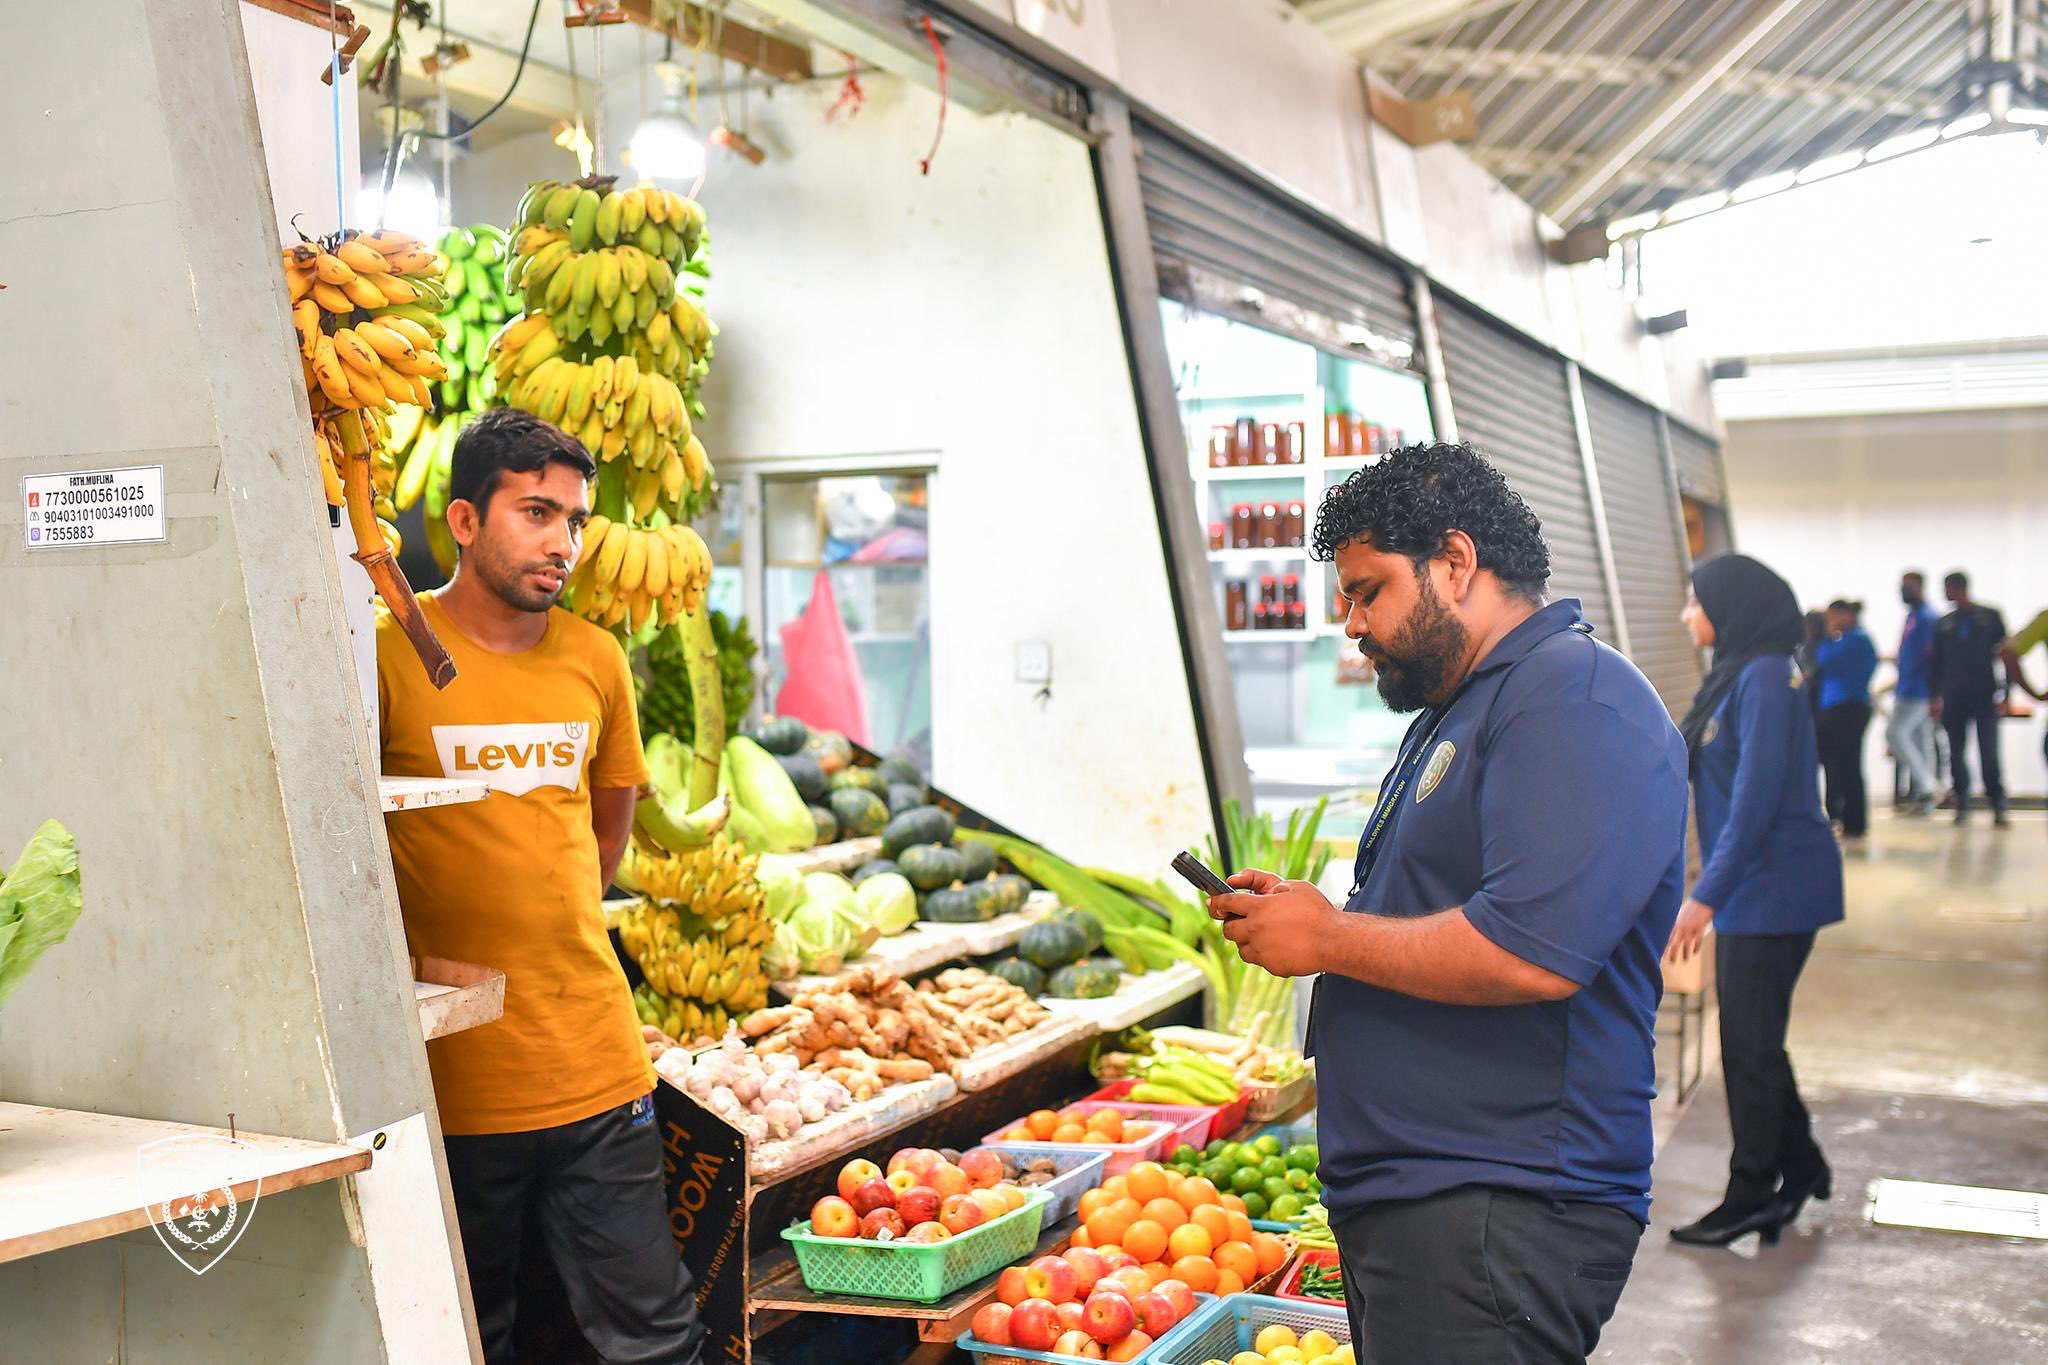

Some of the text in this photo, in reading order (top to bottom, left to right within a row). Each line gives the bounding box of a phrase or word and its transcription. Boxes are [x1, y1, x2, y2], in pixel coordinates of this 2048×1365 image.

[45, 485, 144, 506] 7730000561025
[44, 504, 154, 523] 90403101003491000
[45, 526, 94, 541] 7555883
[1366, 780, 1406, 849] MALDIVES IMMIGRATION
[670, 1152, 724, 1258] WOO
